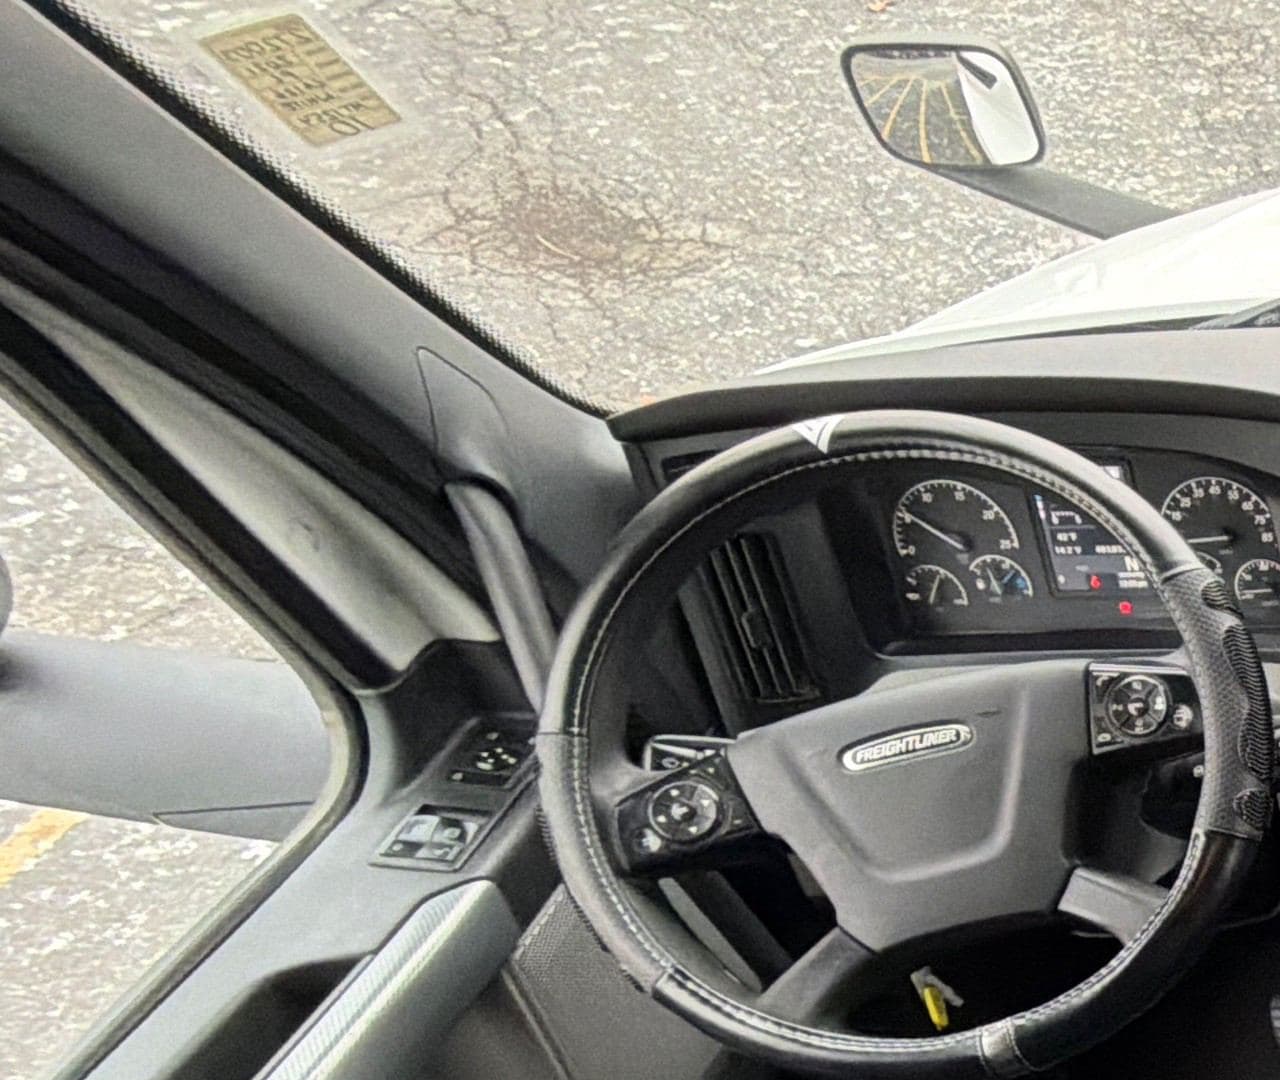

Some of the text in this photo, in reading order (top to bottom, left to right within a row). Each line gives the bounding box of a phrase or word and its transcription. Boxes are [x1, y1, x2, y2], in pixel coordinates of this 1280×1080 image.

[1192, 487, 1204, 498] 35
[1208, 485, 1221, 495] 45
[1227, 489, 1239, 500] 55
[922, 492, 933, 503] 10
[954, 491, 965, 501] 15
[1241, 501, 1254, 510] 65
[982, 509, 995, 520] 20
[1171, 511, 1182, 521] 15
[1254, 514, 1266, 525] 75
[1261, 532, 1273, 543] 85
[999, 539, 1012, 550] 25
[1123, 555, 1139, 572] N
[855, 728, 958, 764] FREIGHTLINER
